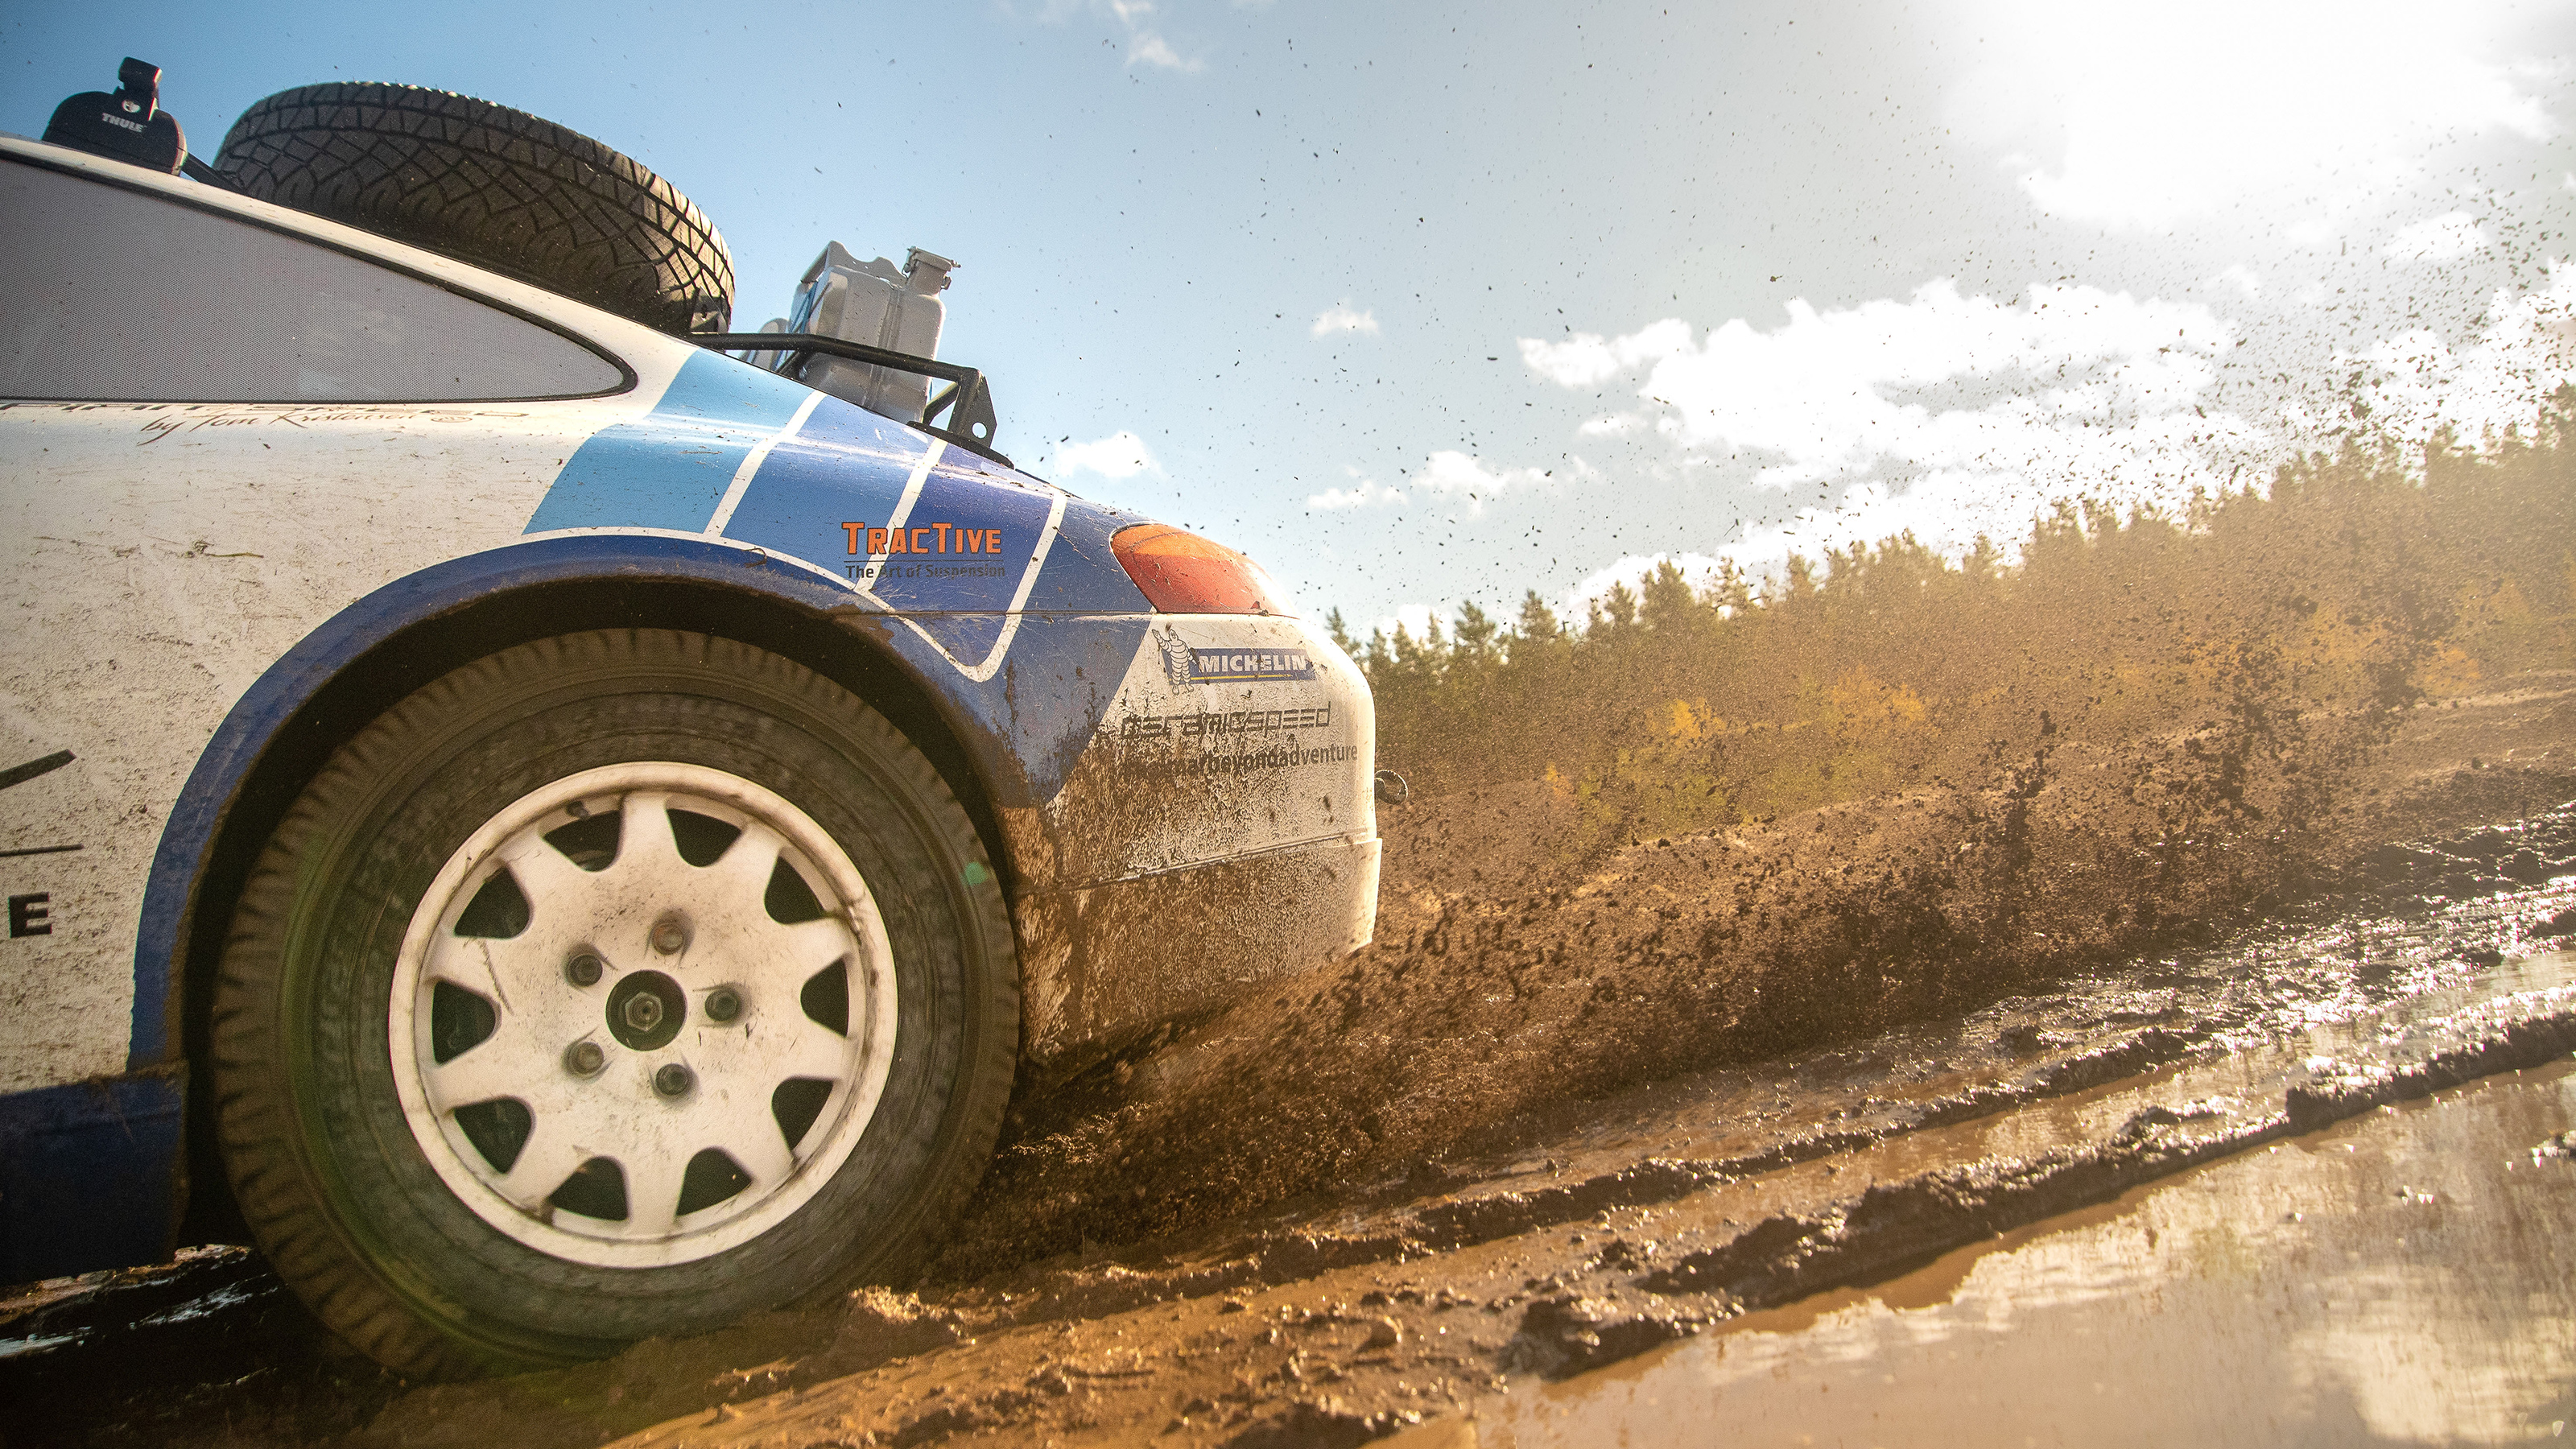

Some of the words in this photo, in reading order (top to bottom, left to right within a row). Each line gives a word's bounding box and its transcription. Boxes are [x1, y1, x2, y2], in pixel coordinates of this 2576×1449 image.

[101, 112, 143, 133] THULE
[136, 414, 187, 447] by
[186, 406, 259, 433] Tom
[845, 565, 874, 579] The
[878, 564, 902, 579] Art
[906, 564, 921, 579] of
[926, 564, 1005, 580] Suspension
[1199, 654, 1308, 674] MICHELIN
